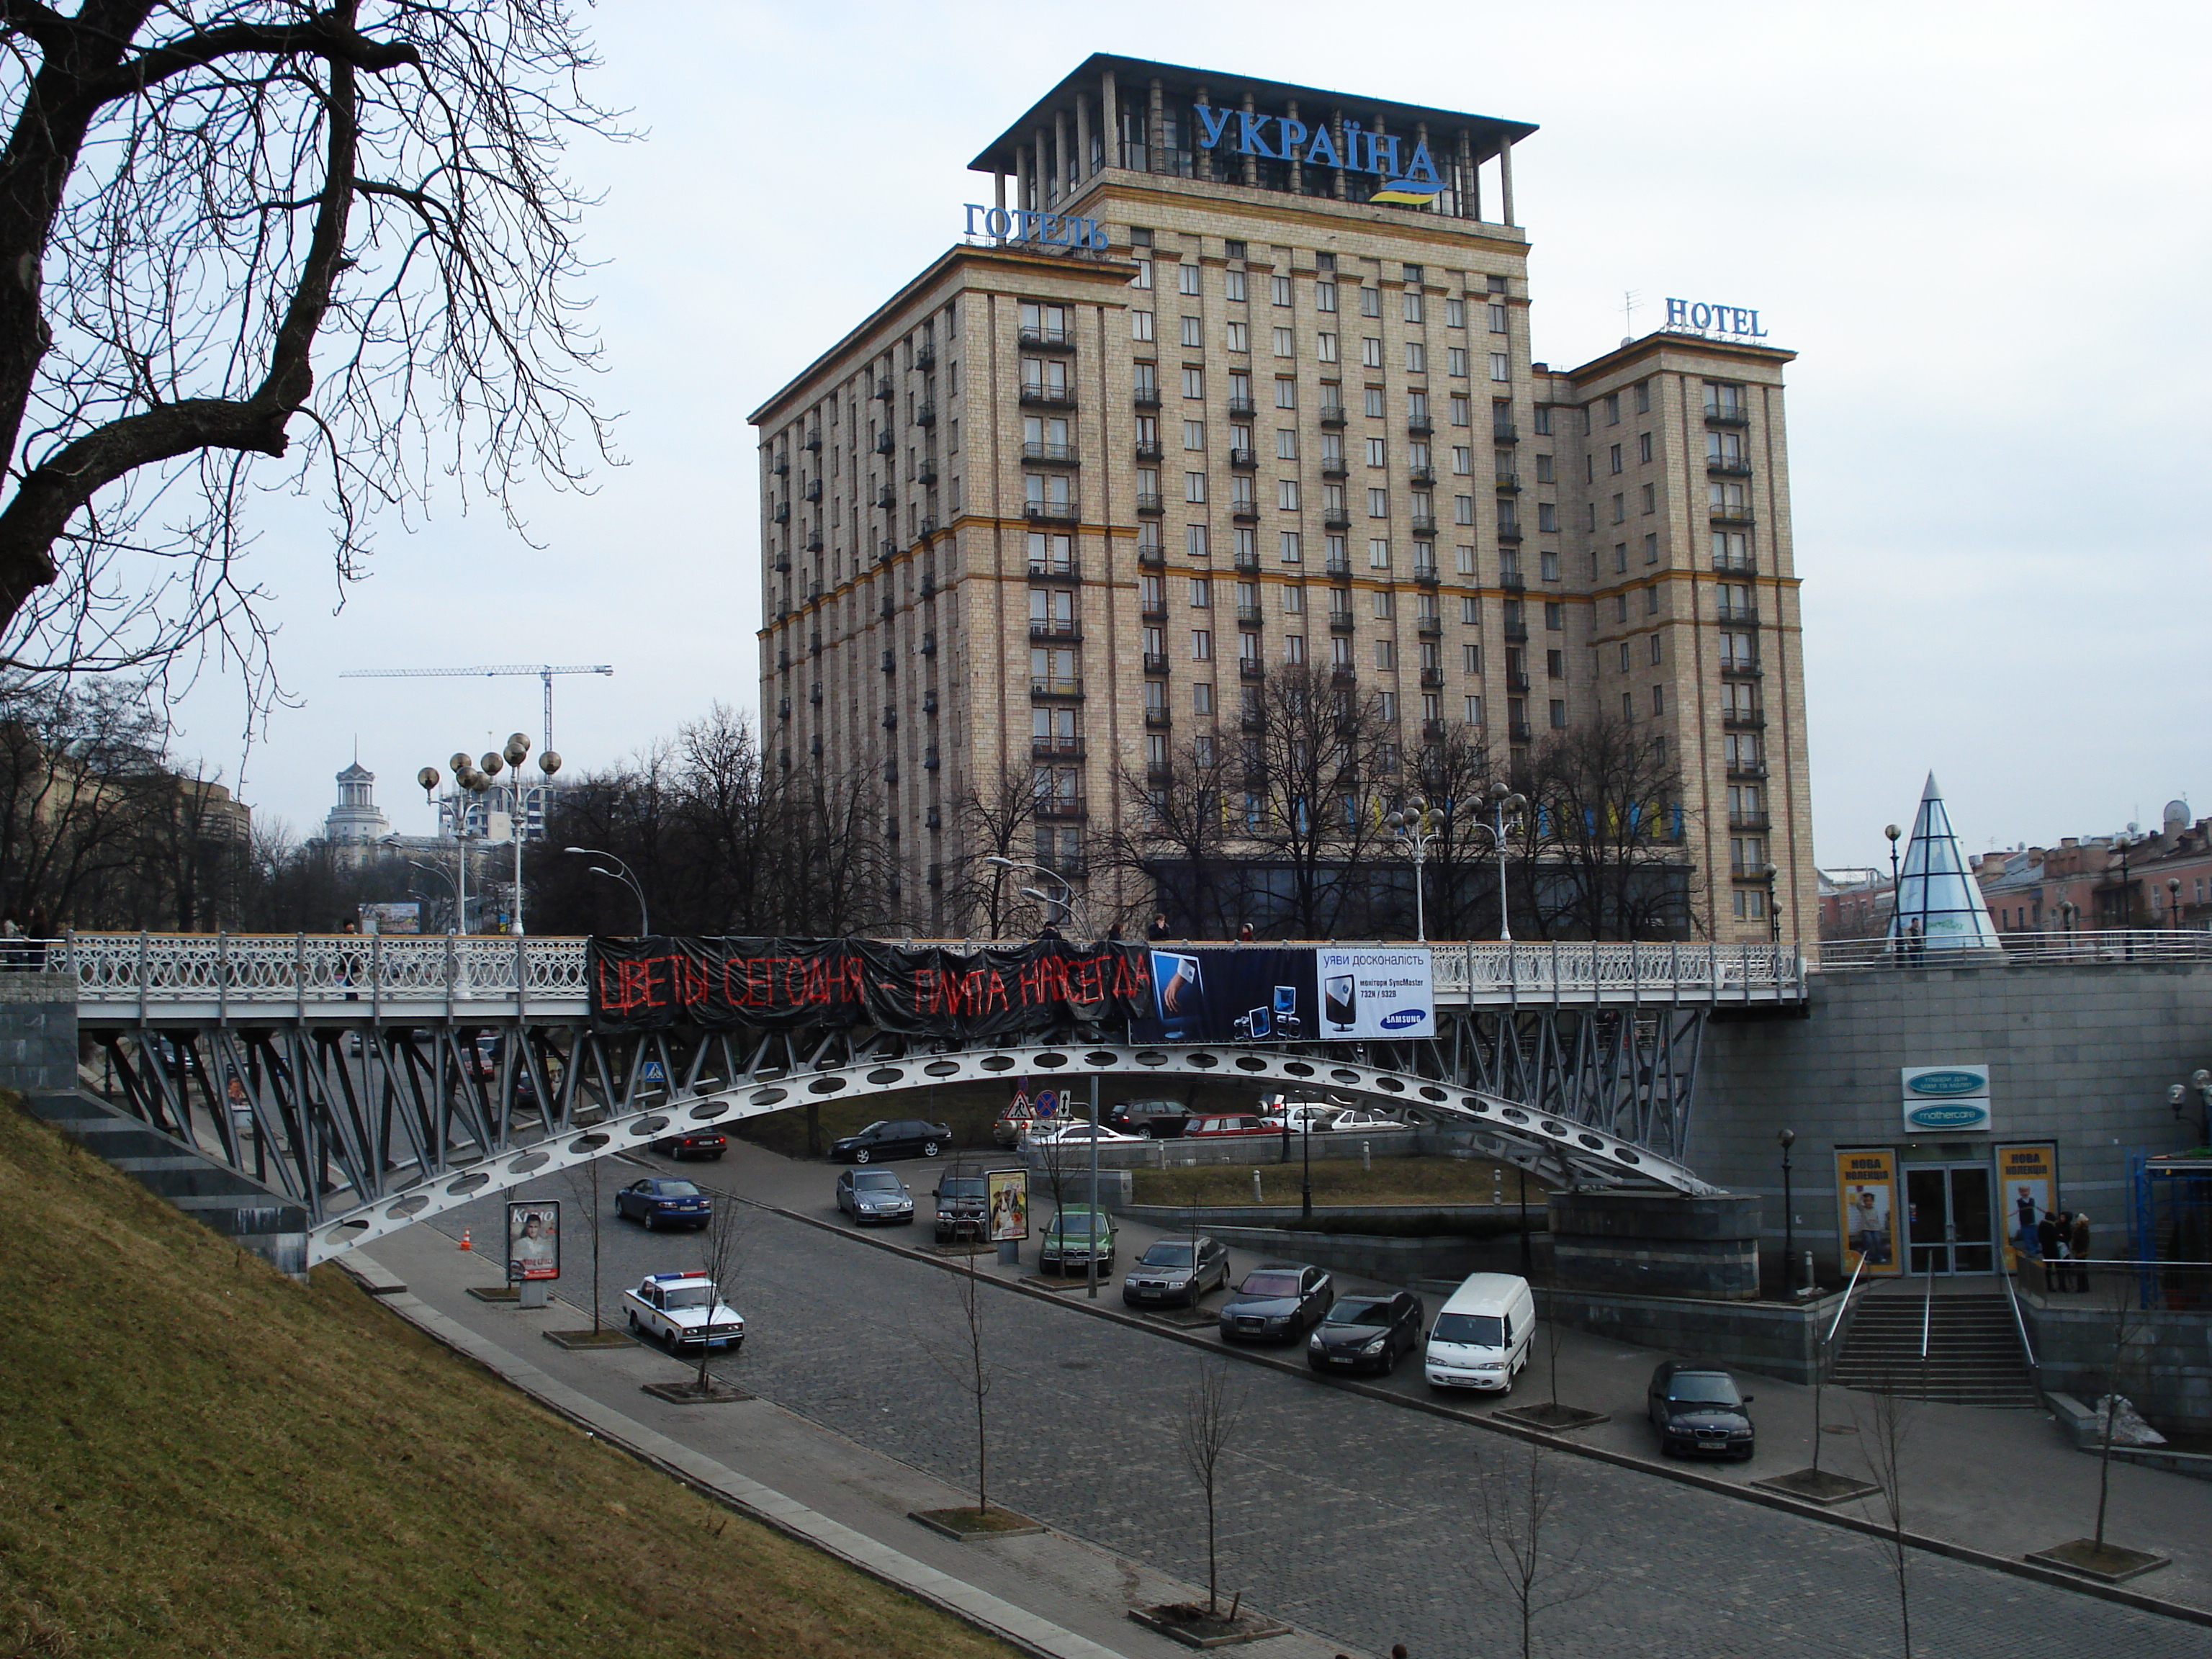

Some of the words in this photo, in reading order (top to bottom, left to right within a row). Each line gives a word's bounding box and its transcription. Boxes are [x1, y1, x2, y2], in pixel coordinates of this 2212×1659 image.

[1194, 104, 1441, 184] УКРАЇНА
[963, 203, 1109, 250] ГОТЕЛЬ
[1665, 297, 1768, 337] HOTEL
[1323, 955, 1349, 968] уяви
[1353, 953, 1424, 966] досконалість
[600, 955, 708, 1016] ЦВЕТЫ
[724, 957, 863, 1005] СЕГОДНЯ
[1360, 979, 1387, 987] монітори
[1389, 979, 1423, 987] SyncMaster
[1920, 1110, 1976, 1119] mothercare
[1851, 1159, 1881, 1169] НОВА
[2012, 1154, 2040, 1164] НОВА
